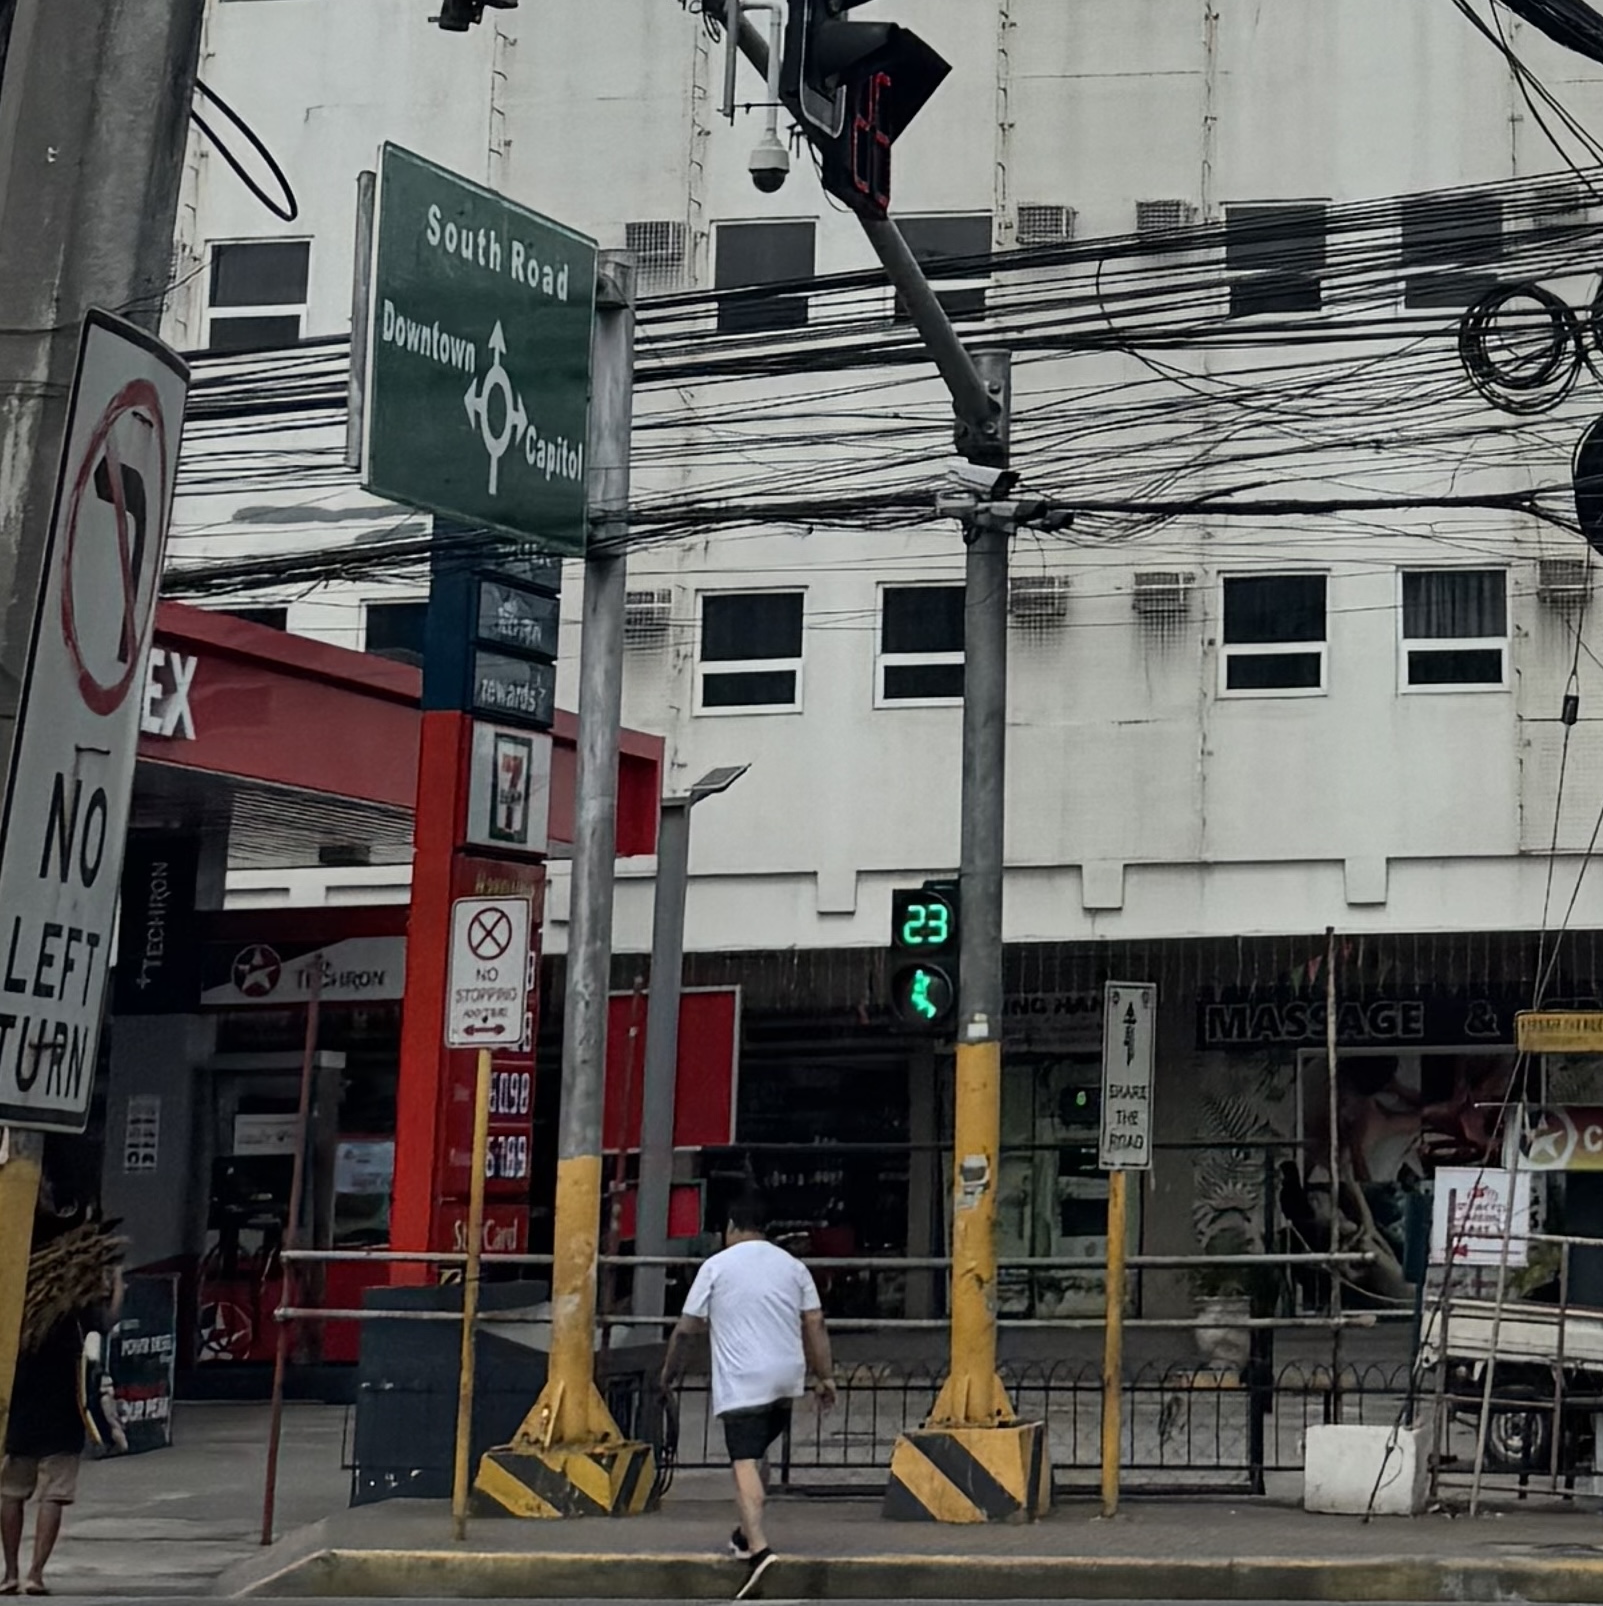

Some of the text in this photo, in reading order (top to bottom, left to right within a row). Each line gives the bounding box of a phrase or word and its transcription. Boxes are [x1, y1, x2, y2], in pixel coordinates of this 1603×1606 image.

[426, 203, 569, 302] South Road
[382, 298, 476, 374] Downtown
[525, 424, 584, 482] Capitol
[39, 771, 108, 889] NO
[903, 903, 948, 944] 23
[3, 915, 101, 1008] LEFT
[476, 966, 499, 982] NO
[1205, 1000, 1424, 1043] MASSAGE
[0, 1012, 89, 1100] TURN
[1108, 1084, 1148, 1100] SHARE
[1109, 1133, 1145, 1152] ROAD
[1115, 1110, 1139, 1126] THE
